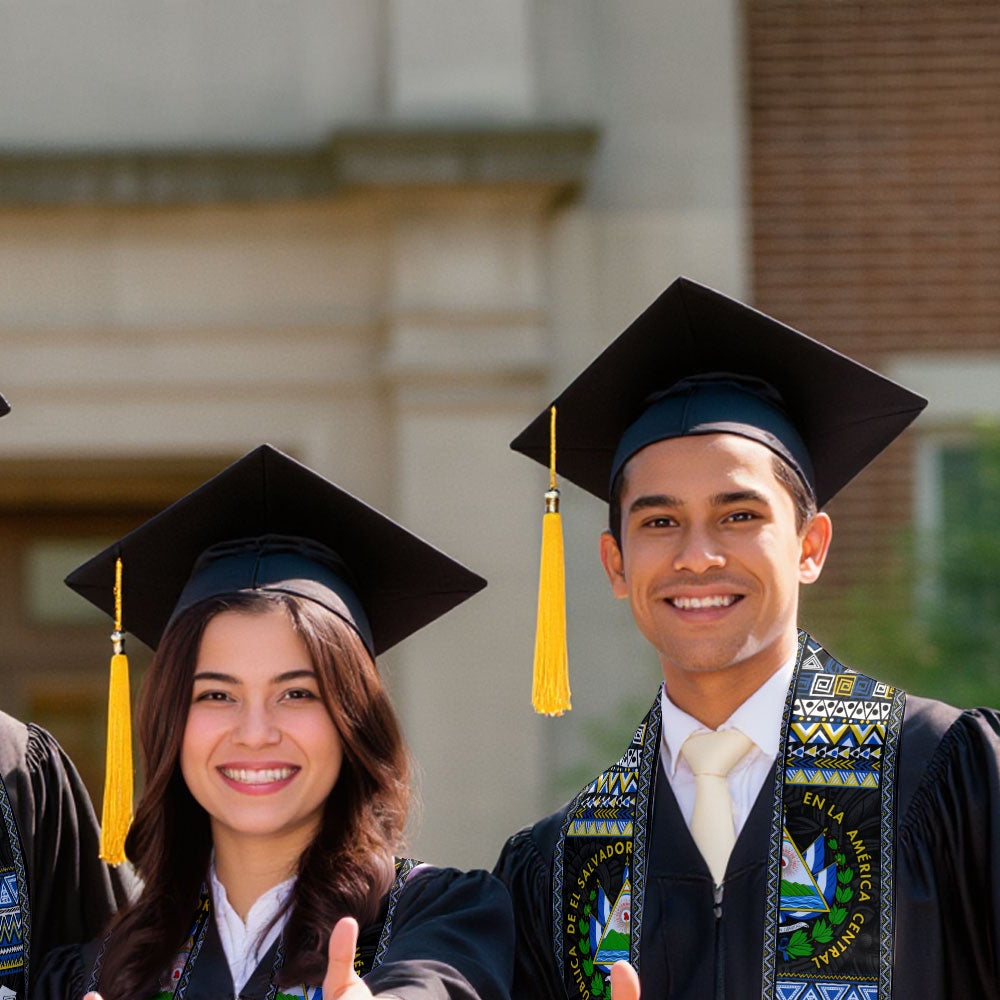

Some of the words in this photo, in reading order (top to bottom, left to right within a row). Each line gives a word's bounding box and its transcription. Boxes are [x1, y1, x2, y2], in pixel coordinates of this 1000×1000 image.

[803, 791, 826, 810] EN
[826, 804, 844, 825] LA
[577, 841, 633, 889] SALVADOR
[846, 829, 872, 902] AMÉRICA
[570, 893, 581, 910] EL
[567, 915, 577, 935] DE
[810, 912, 865, 969] CENTRAL
